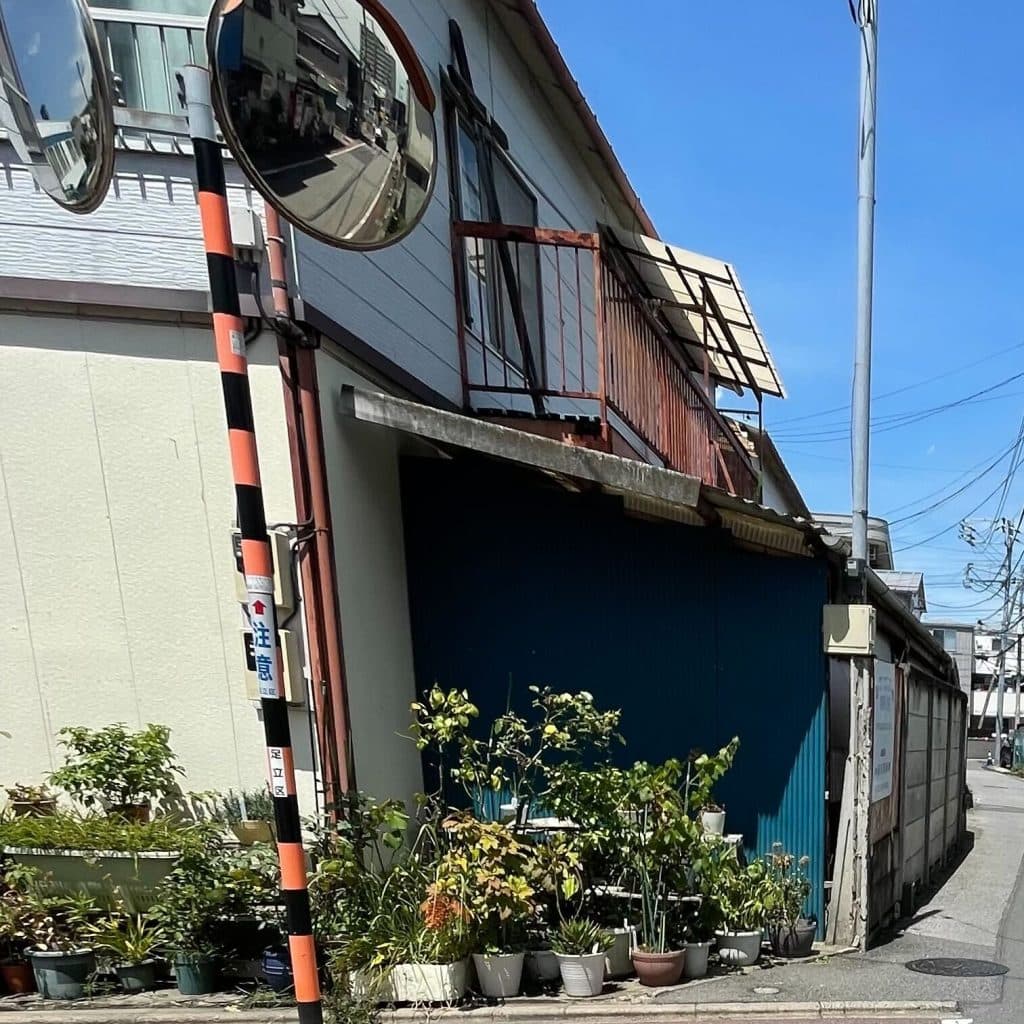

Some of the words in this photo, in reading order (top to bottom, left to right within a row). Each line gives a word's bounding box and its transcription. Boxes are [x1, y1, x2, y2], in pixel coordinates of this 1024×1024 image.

[253, 621, 273, 681] 注意
[271, 748, 285, 796] 足立区
